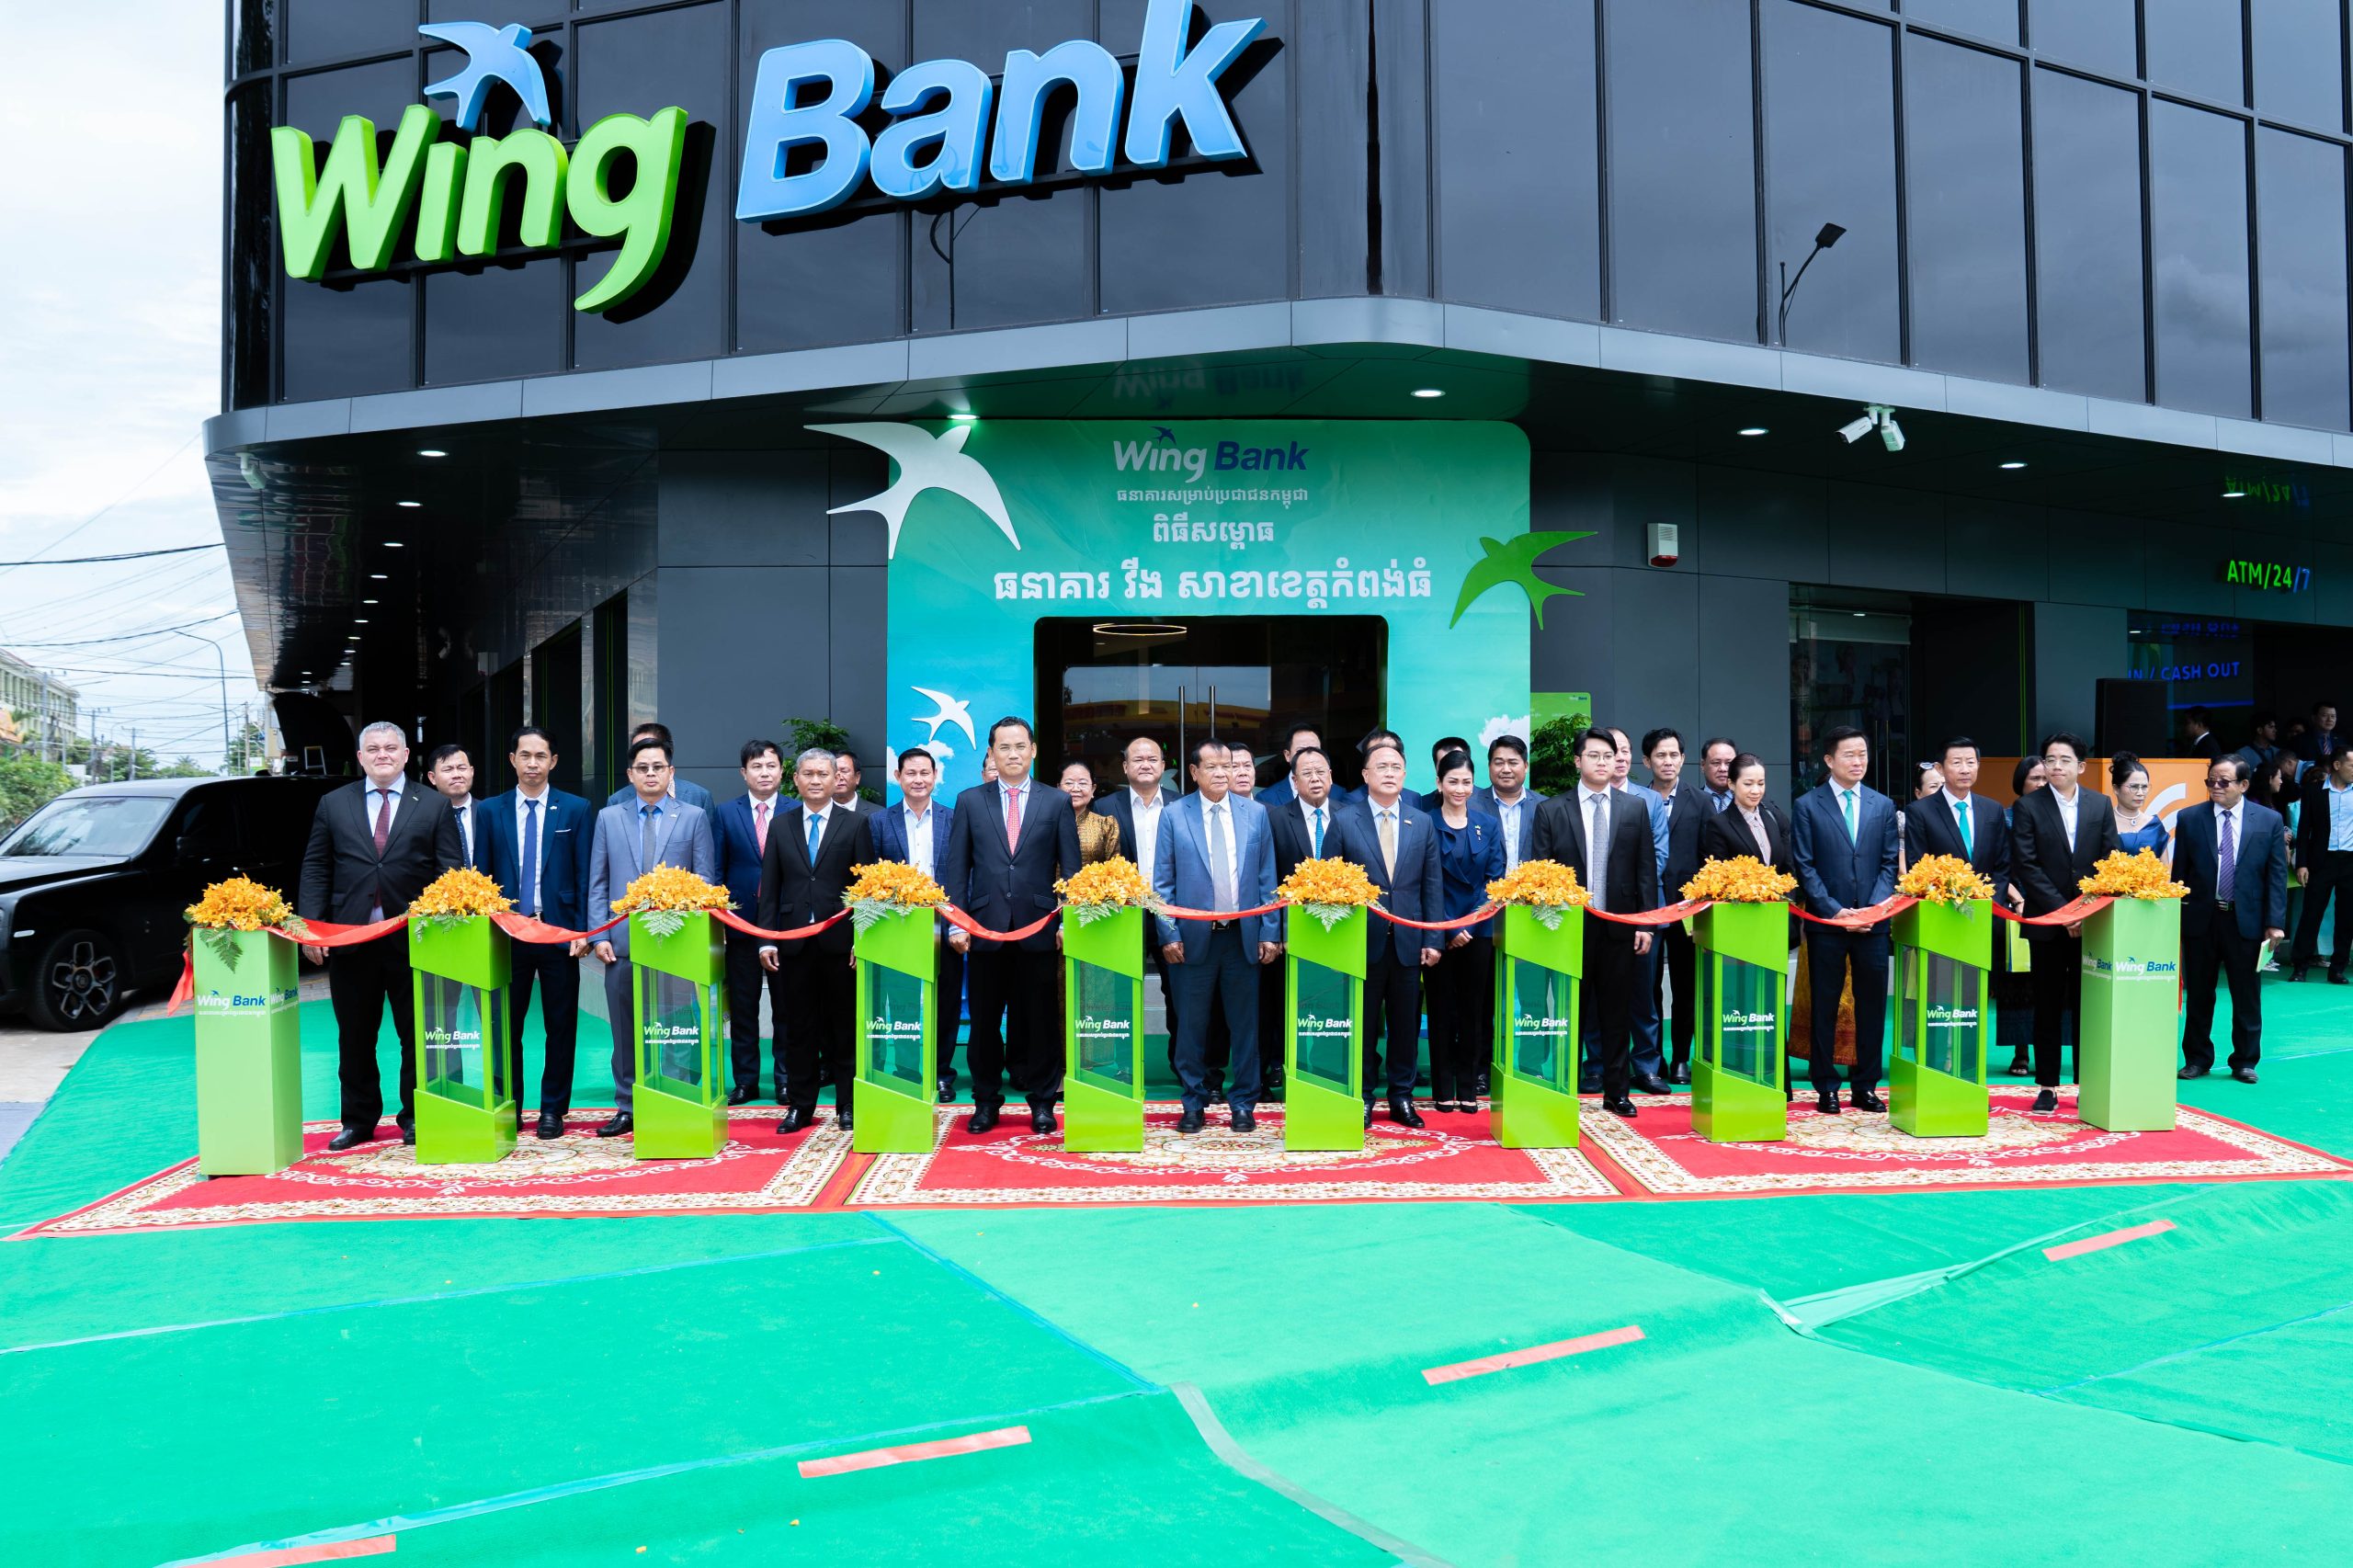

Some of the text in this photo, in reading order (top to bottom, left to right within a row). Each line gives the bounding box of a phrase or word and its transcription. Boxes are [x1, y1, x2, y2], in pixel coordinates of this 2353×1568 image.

[270, 0, 1267, 314] Wing Bank
[1113, 440, 1310, 483] Wing Bank
[1153, 512, 1275, 550] ពិធីសម្ពោធ
[994, 571, 1110, 600] ធនាគារ
[1177, 556, 1432, 609] សាខាខេត្តកំពង់ធំ
[2227, 559, 2310, 594] ATM/24/7
[2161, 665, 2201, 681] CASH
[2207, 662, 2240, 677] OUT
[2115, 961, 2145, 975] Wing
[2146, 960, 2177, 971] Bank
[198, 995, 267, 1010] Wing Bank
[1722, 1012, 1775, 1026] Wing Bank
[1927, 1008, 1978, 1021] Wing Bank
[866, 1020, 922, 1034] Wing Bank
[1074, 1019, 1131, 1032] Wing Bank
[1297, 1017, 1353, 1031] Wing Bank
[1514, 1017, 1568, 1030] Wing Bank
[425, 1030, 481, 1043] Wing Bank
[643, 1026, 699, 1039] Wing Bank
